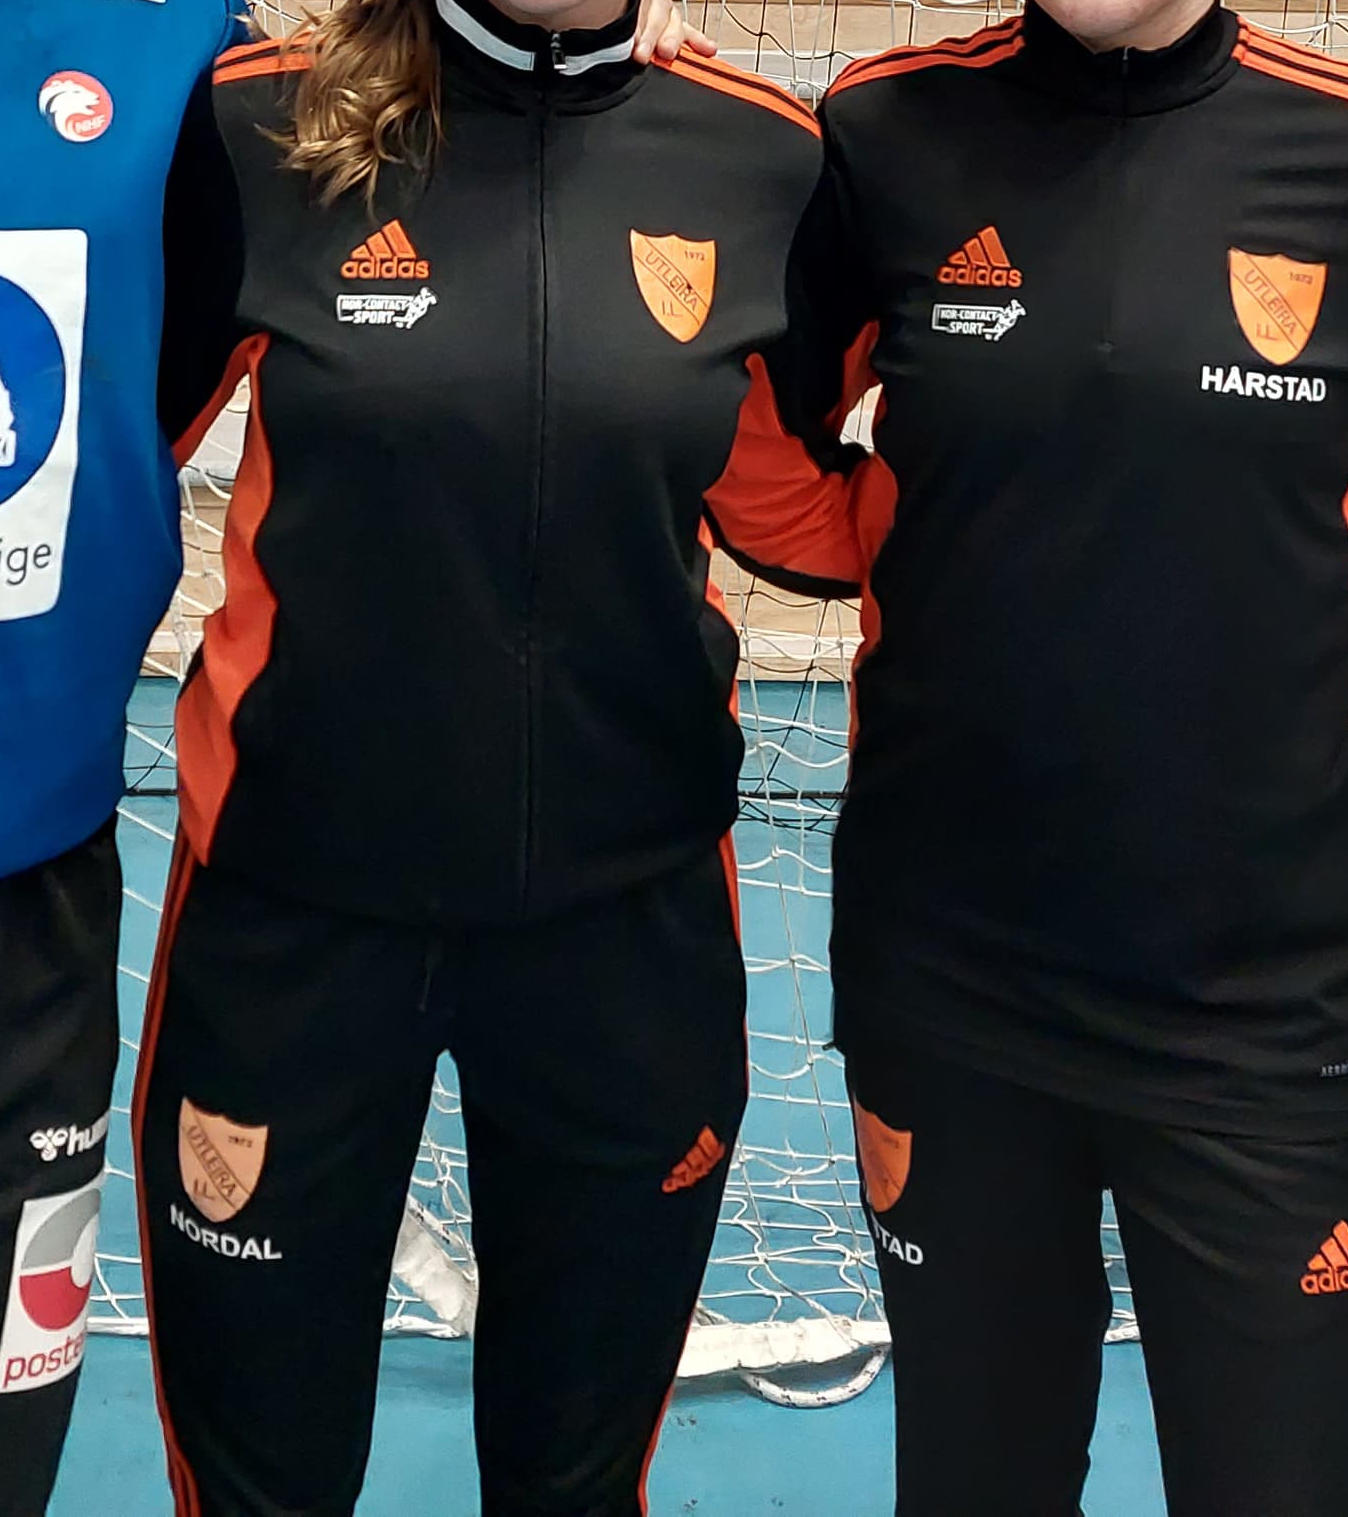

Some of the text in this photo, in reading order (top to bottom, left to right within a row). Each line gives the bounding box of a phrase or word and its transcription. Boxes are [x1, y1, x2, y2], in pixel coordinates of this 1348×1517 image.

[74, 114, 105, 134] NHF
[341, 256, 429, 279] adidas
[645, 250, 697, 311] UTLEIRA
[937, 264, 1023, 287] adidas
[353, 310, 395, 324] SPORT
[1244, 269, 1297, 335] UTLEIRA
[949, 321, 984, 335] SPORT
[67, 1111, 108, 1156] hu
[187, 1124, 236, 1196] UTLEIRA
[170, 1204, 283, 1260] NORDAL
